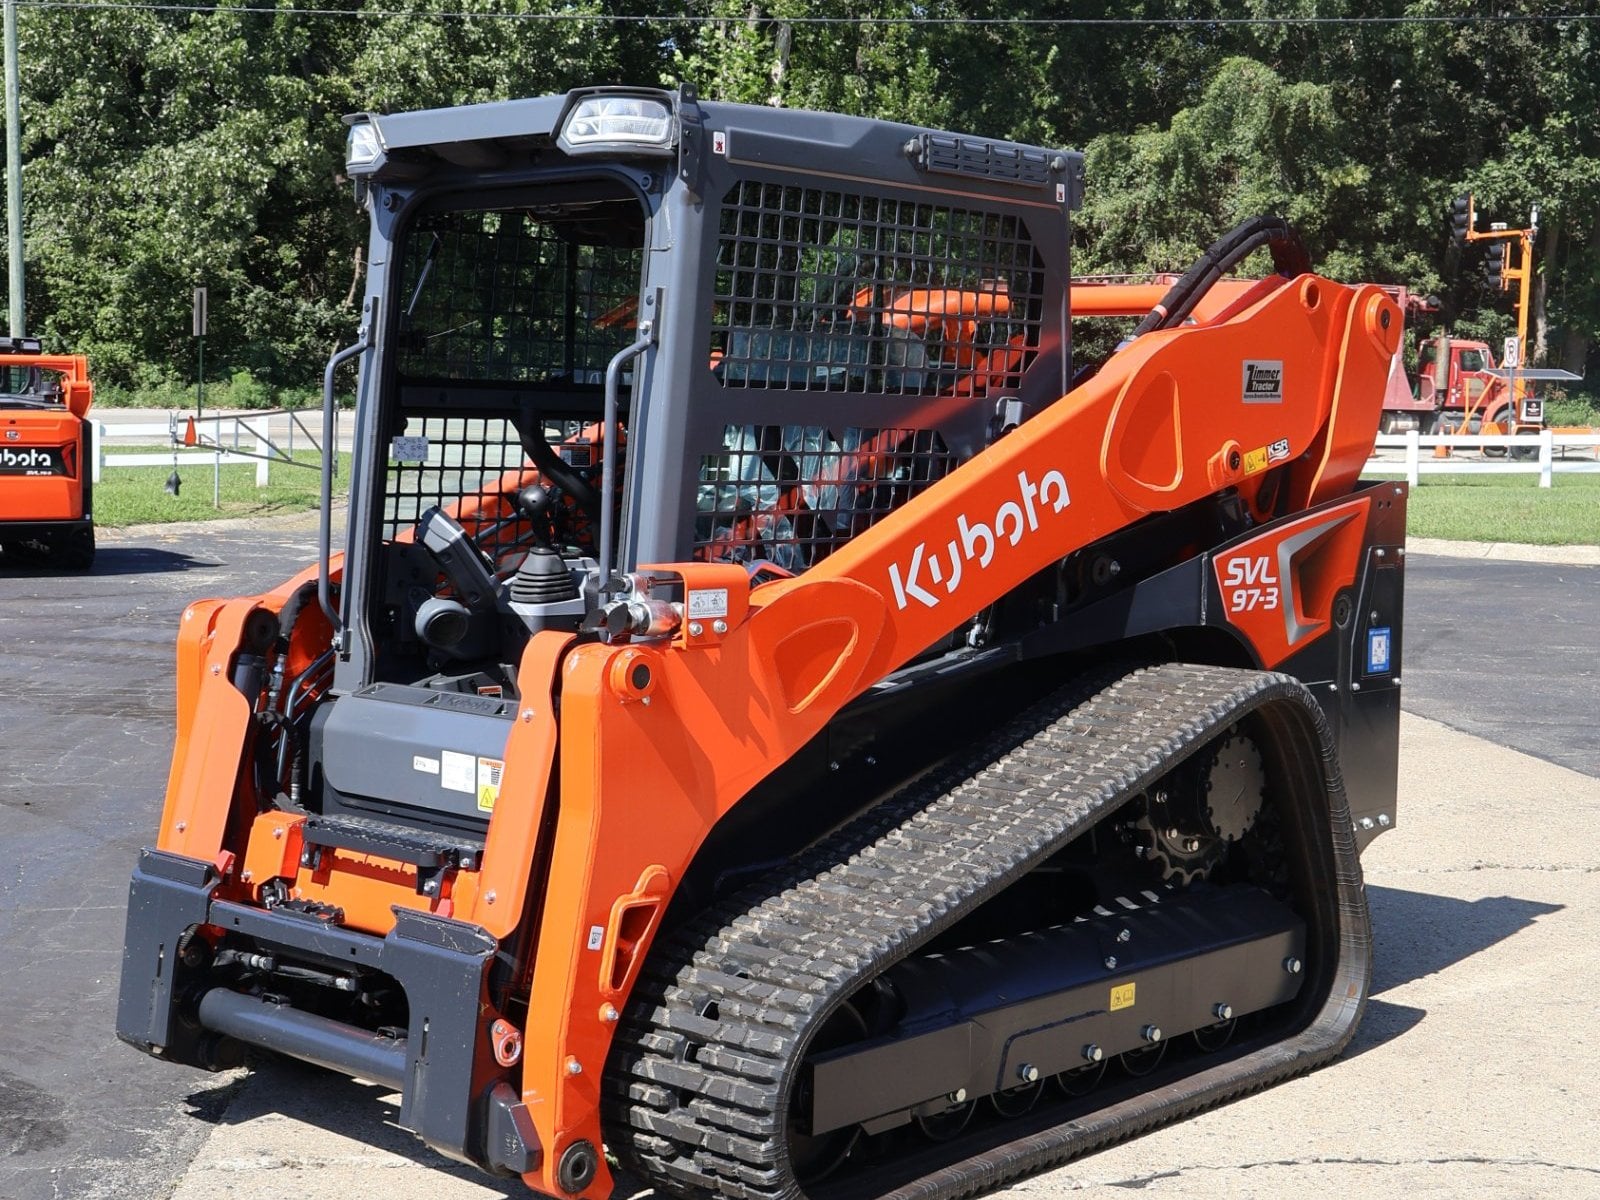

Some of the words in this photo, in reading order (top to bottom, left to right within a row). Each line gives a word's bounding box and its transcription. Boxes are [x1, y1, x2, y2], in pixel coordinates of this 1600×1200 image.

[1246, 364, 1280, 392] Zimmer
[1252, 381, 1275, 391] Tractor
[0, 448, 51, 466] bota
[888, 470, 1071, 610] Kubota
[1223, 556, 1277, 586] SVL
[1231, 587, 1279, 612] 97-3
